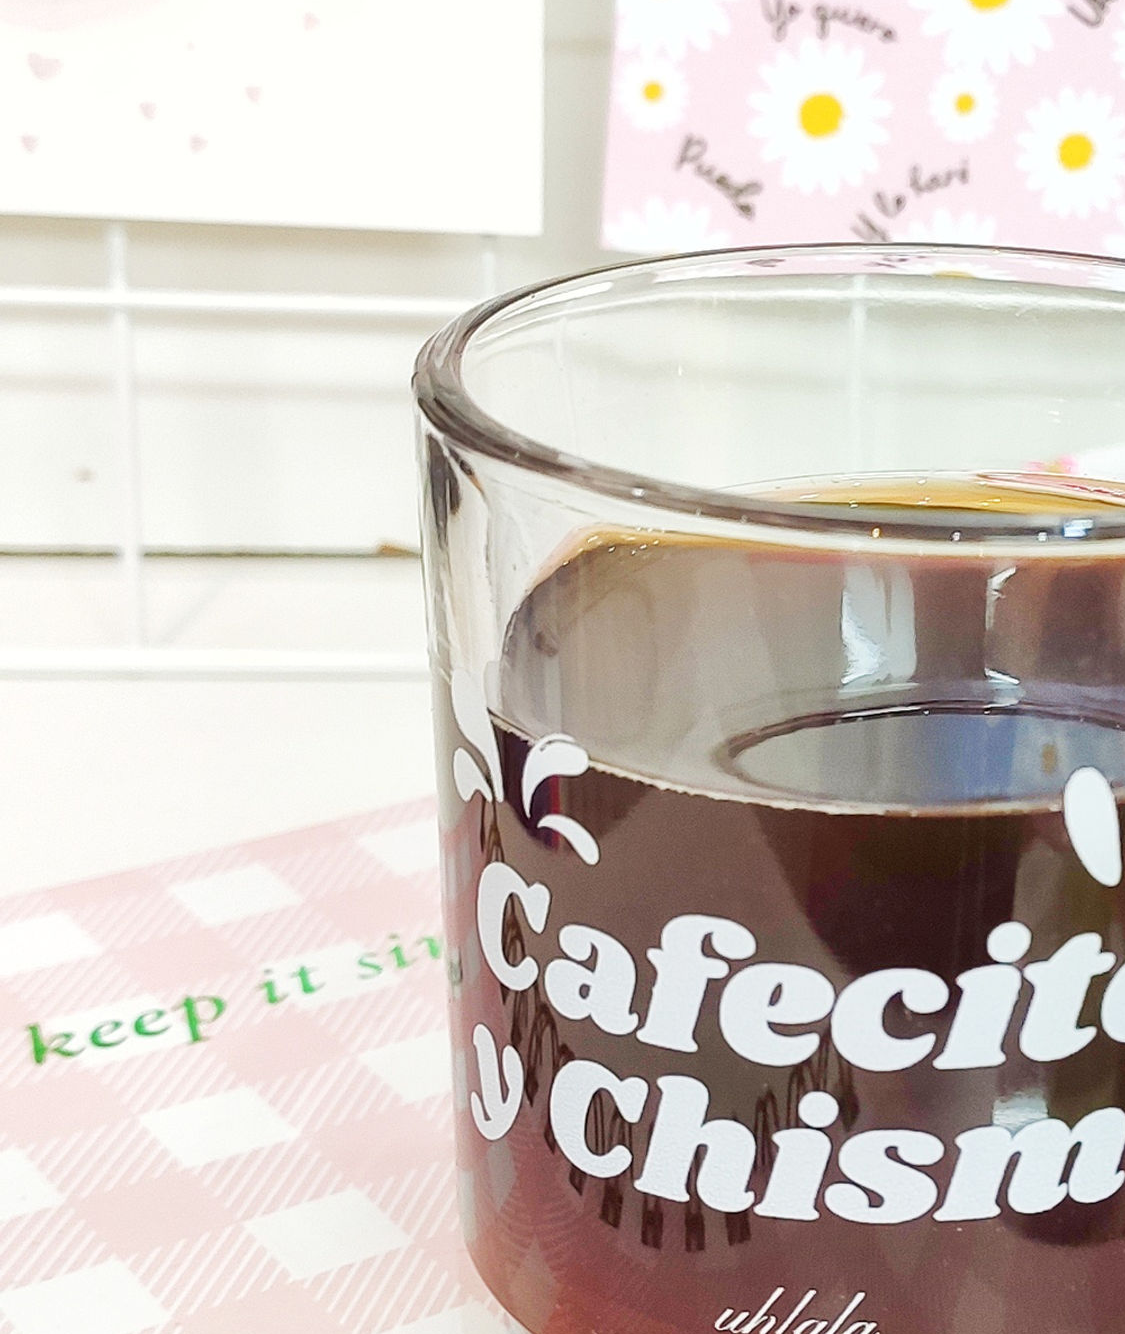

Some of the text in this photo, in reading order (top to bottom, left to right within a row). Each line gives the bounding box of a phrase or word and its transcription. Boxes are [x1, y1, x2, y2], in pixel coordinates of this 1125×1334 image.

[26, 992, 228, 1065] keep
[259, 965, 325, 1005] it
[470, 1023, 523, 1141] y
